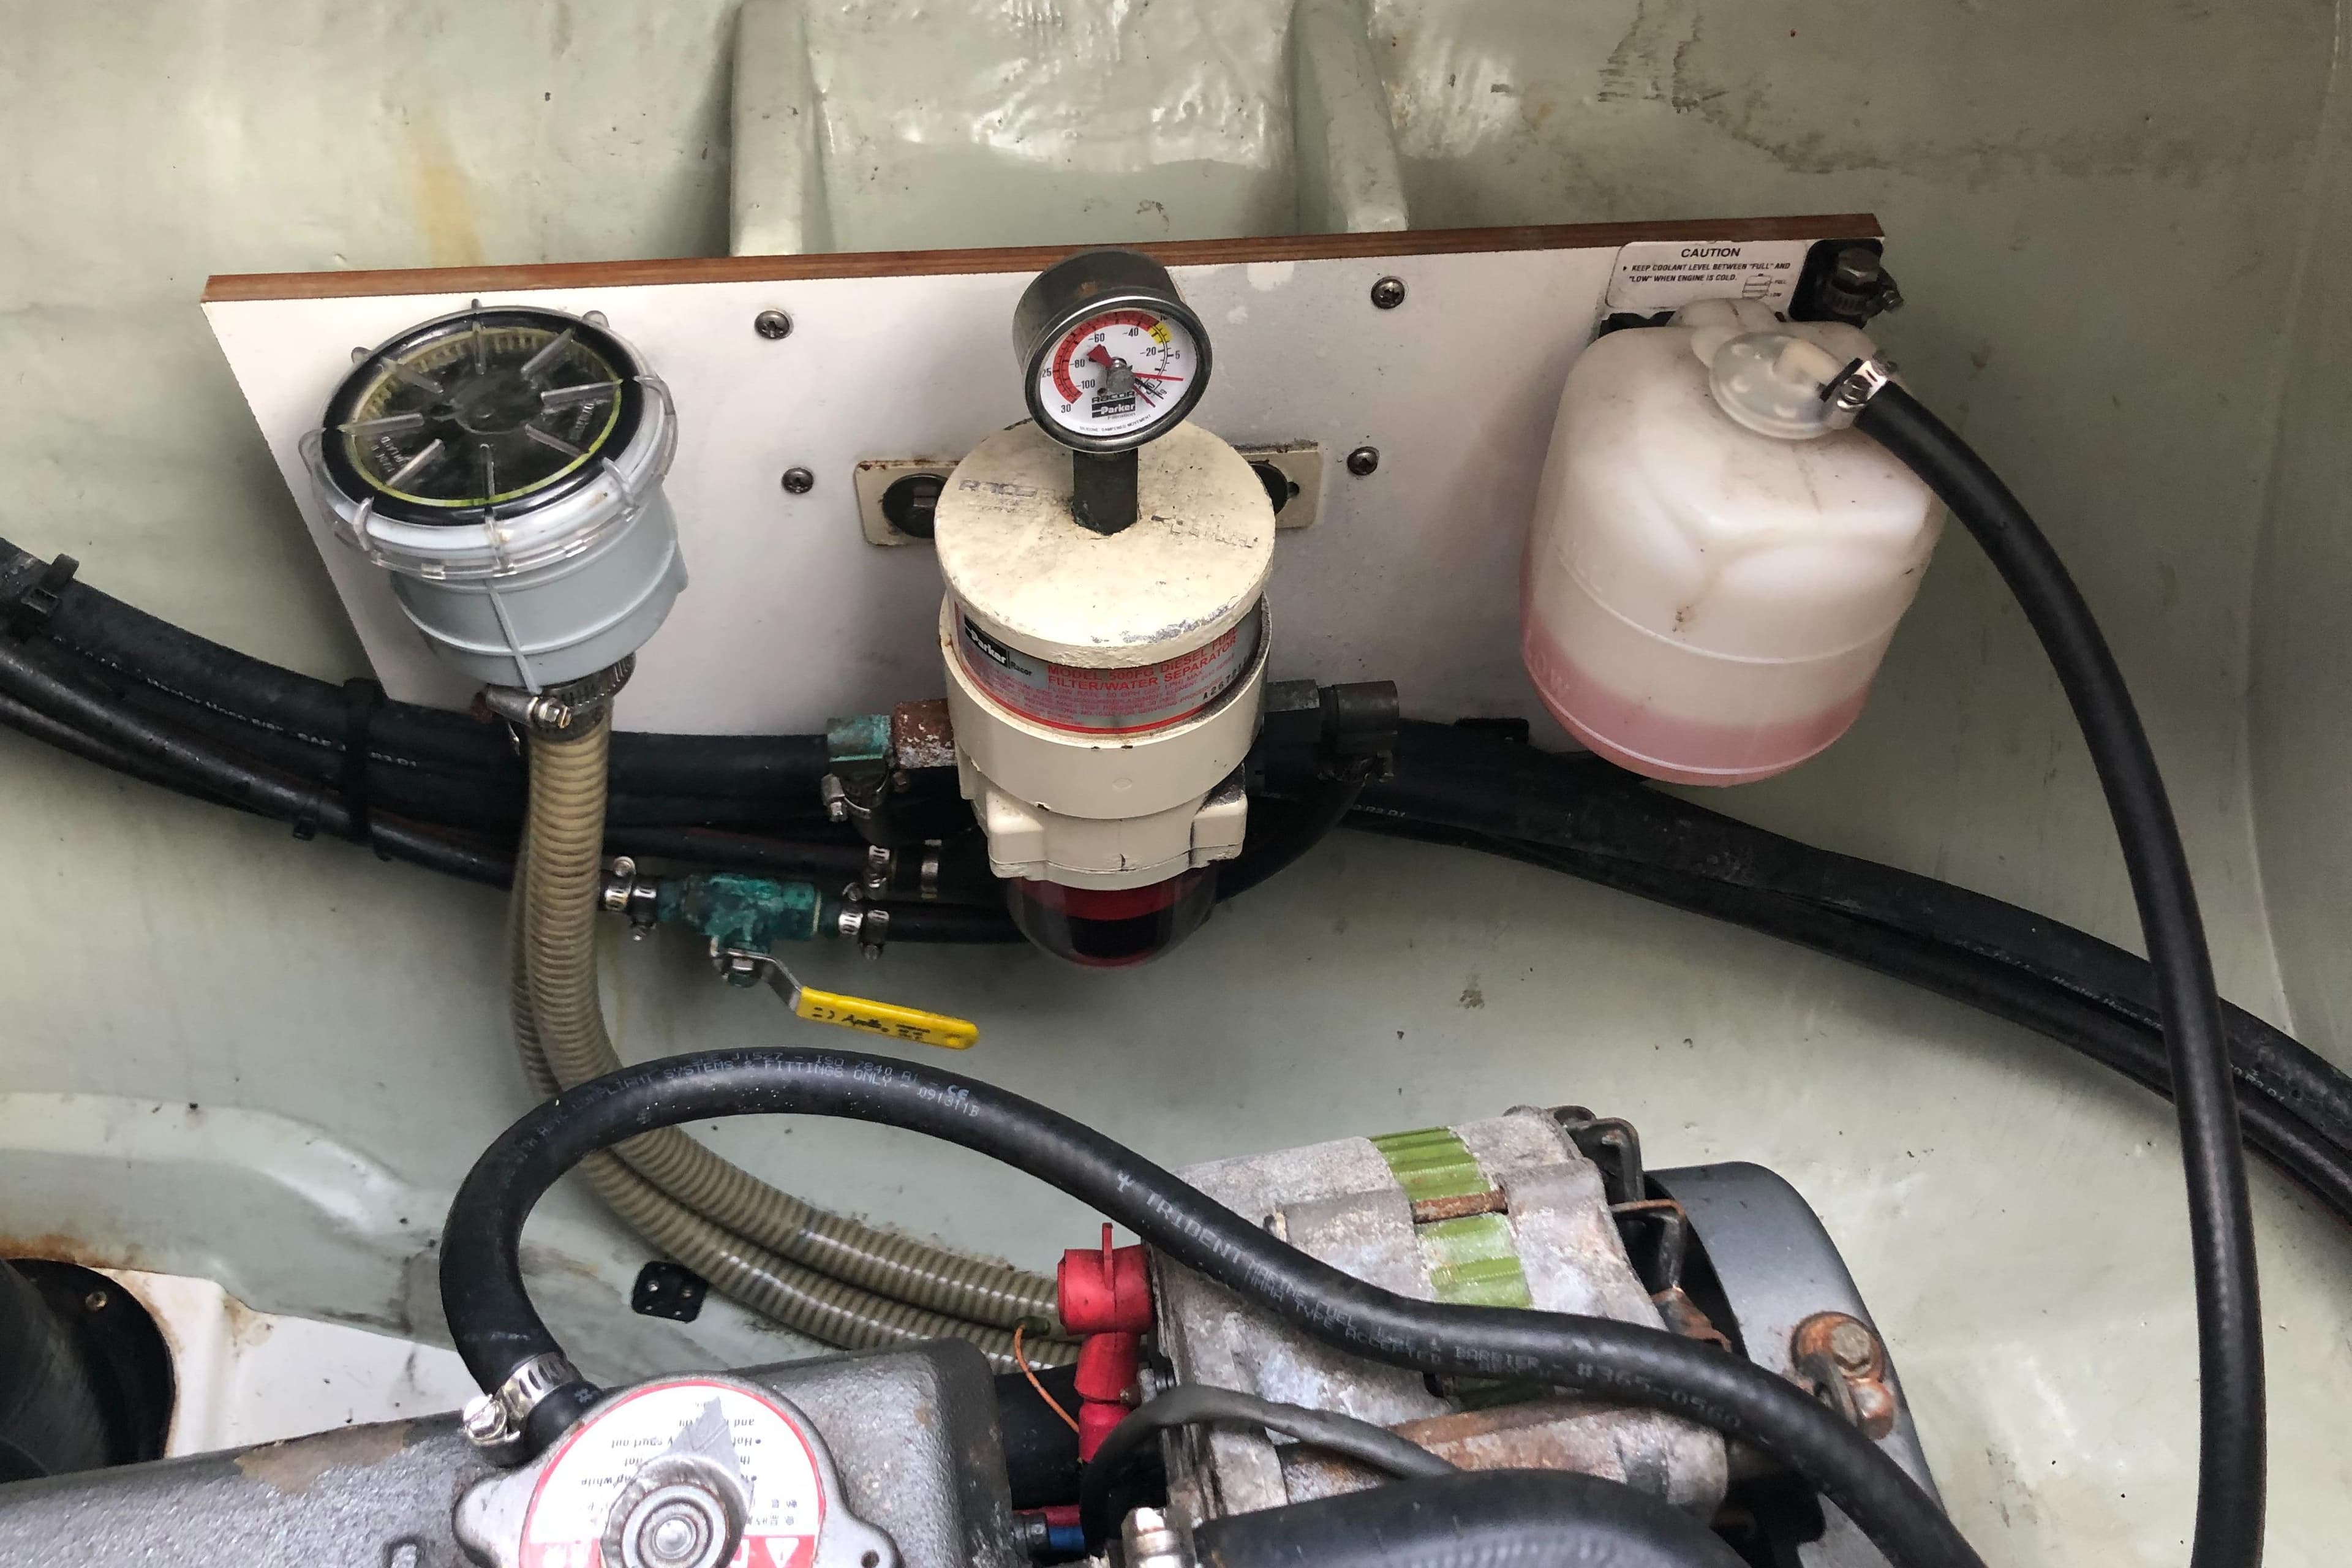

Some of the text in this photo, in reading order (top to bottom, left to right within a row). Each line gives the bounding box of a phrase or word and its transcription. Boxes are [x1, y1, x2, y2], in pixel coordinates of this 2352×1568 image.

[1681, 248, 1741, 258] CAUTION
[1174, 350, 1180, 360] 5
[1042, 368, 1052, 378] 25
[1060, 404, 1071, 413] 30
[1100, 402, 1136, 415] Parker
[1010, 661, 1033, 676] Racor
[1047, 675, 1159, 691] FILTER/WATER
[1164, 635, 1237, 682] SEPARATOR
[1048, 665, 1102, 680] MODEL
[1160, 649, 1207, 673] DIESEL
[663, 1060, 734, 1079] SYSTEMS
[764, 1060, 844, 1078] FITTINGS
[853, 1069, 893, 1087] ONLY
[816, 1055, 845, 1067] ISO
[947, 1084, 970, 1101] CE
[1146, 1189, 1243, 1264] TRIDENT
